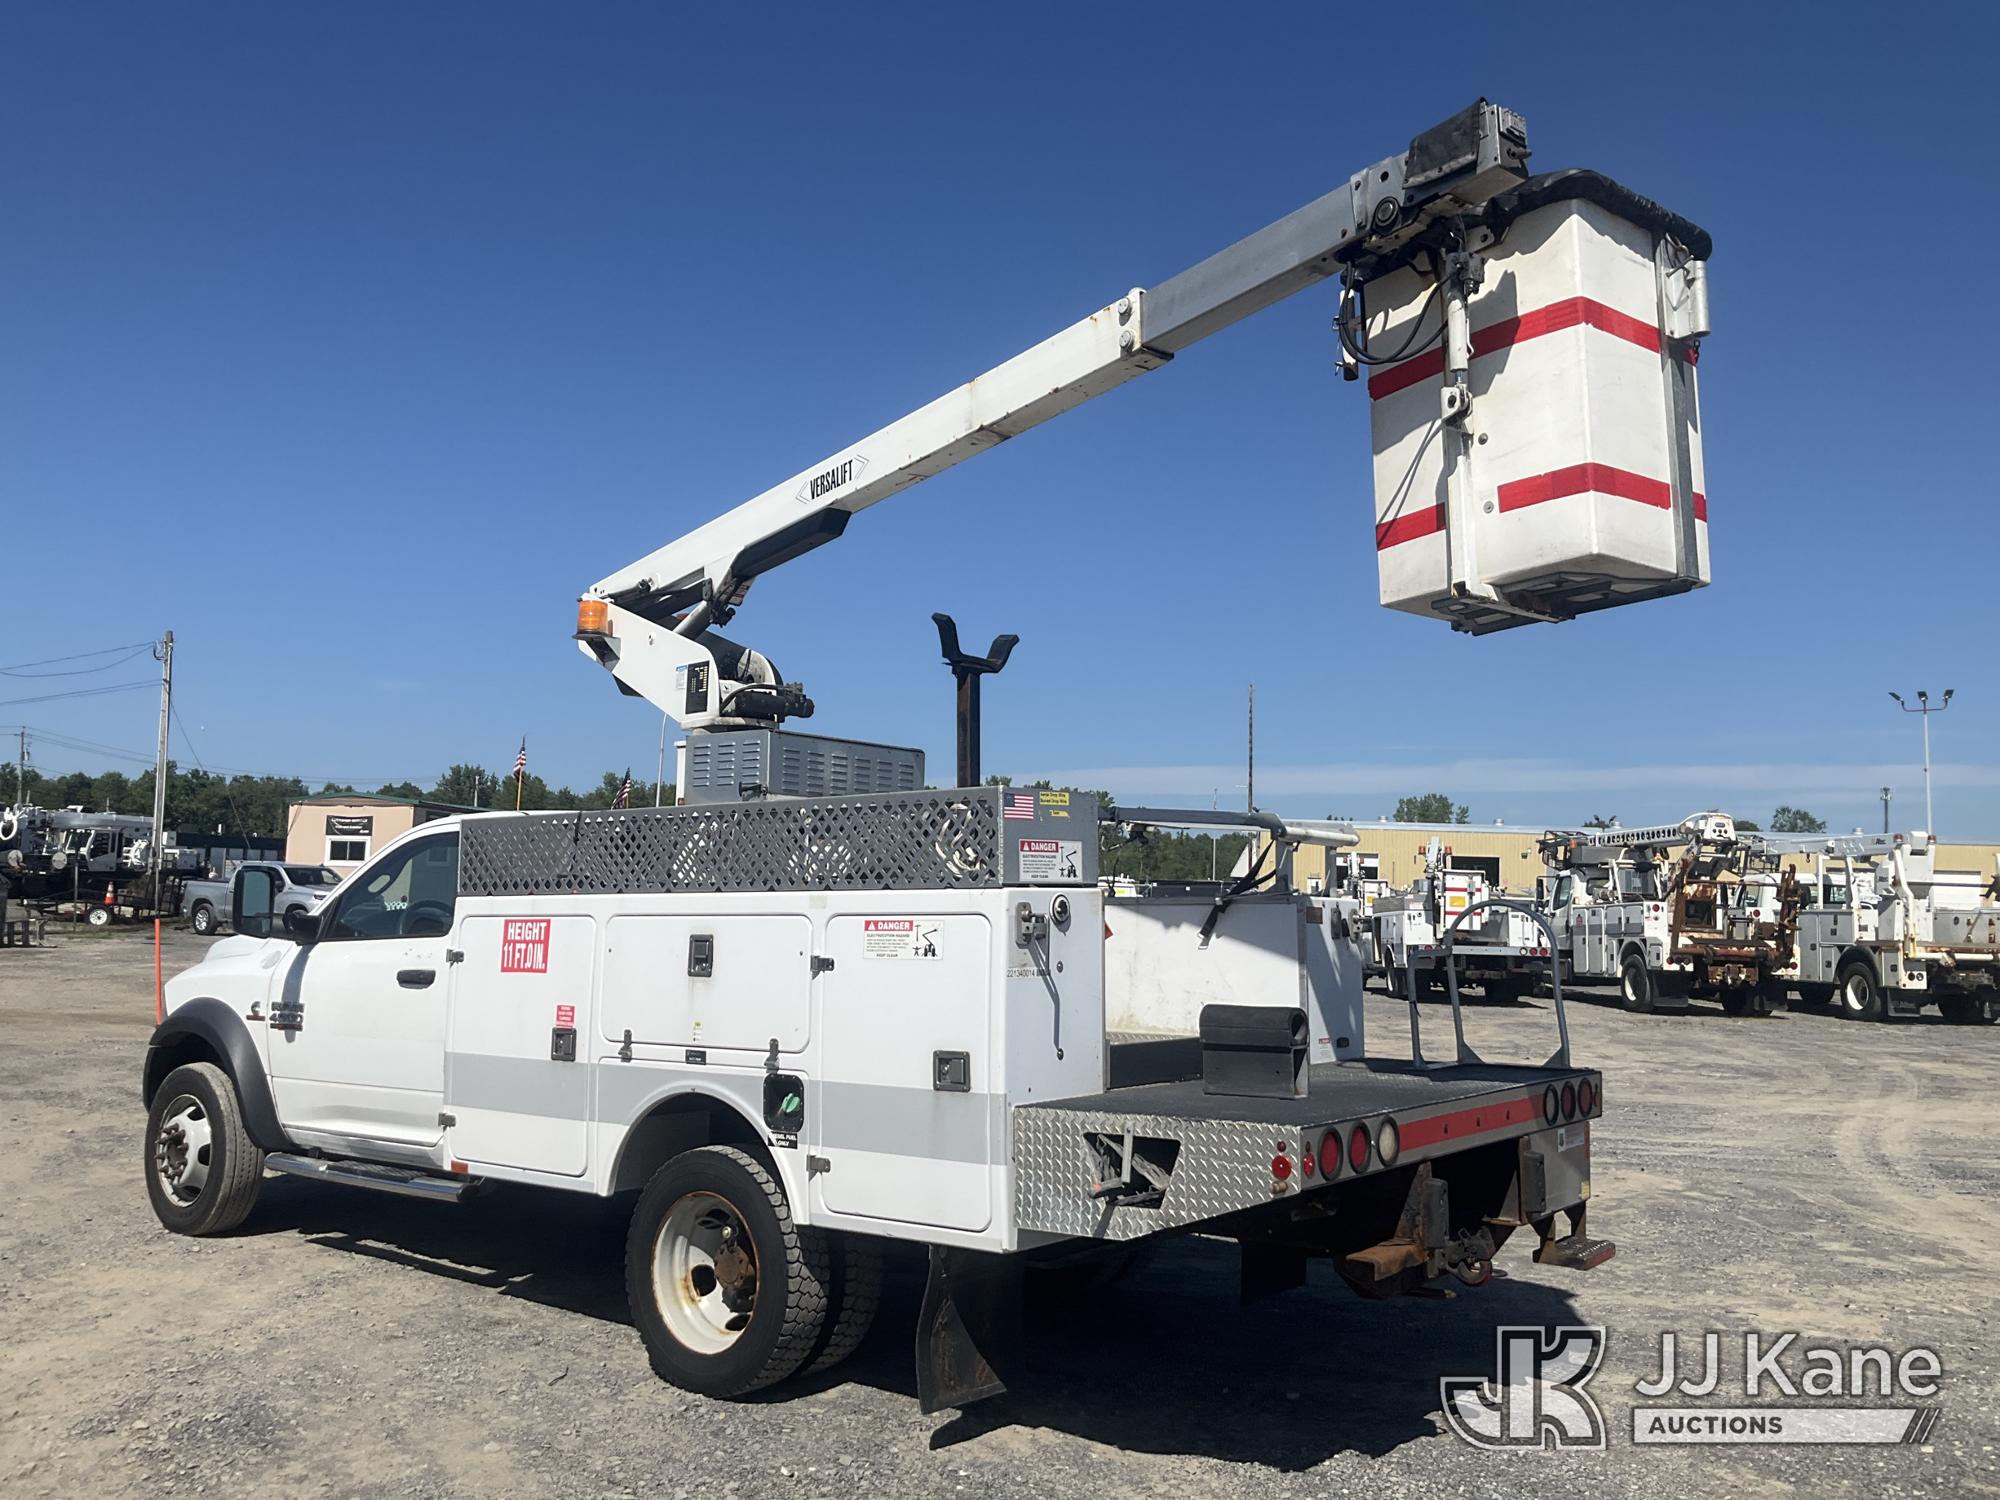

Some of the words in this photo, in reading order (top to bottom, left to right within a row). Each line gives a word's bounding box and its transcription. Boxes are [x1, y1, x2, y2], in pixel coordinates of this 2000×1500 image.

[809, 459, 853, 500] VERSALIFT
[1031, 842, 1056, 851] DANGER
[507, 922, 547, 940] HEIGHT
[877, 921, 910, 930] DANGER
[503, 943, 513, 967] 11
